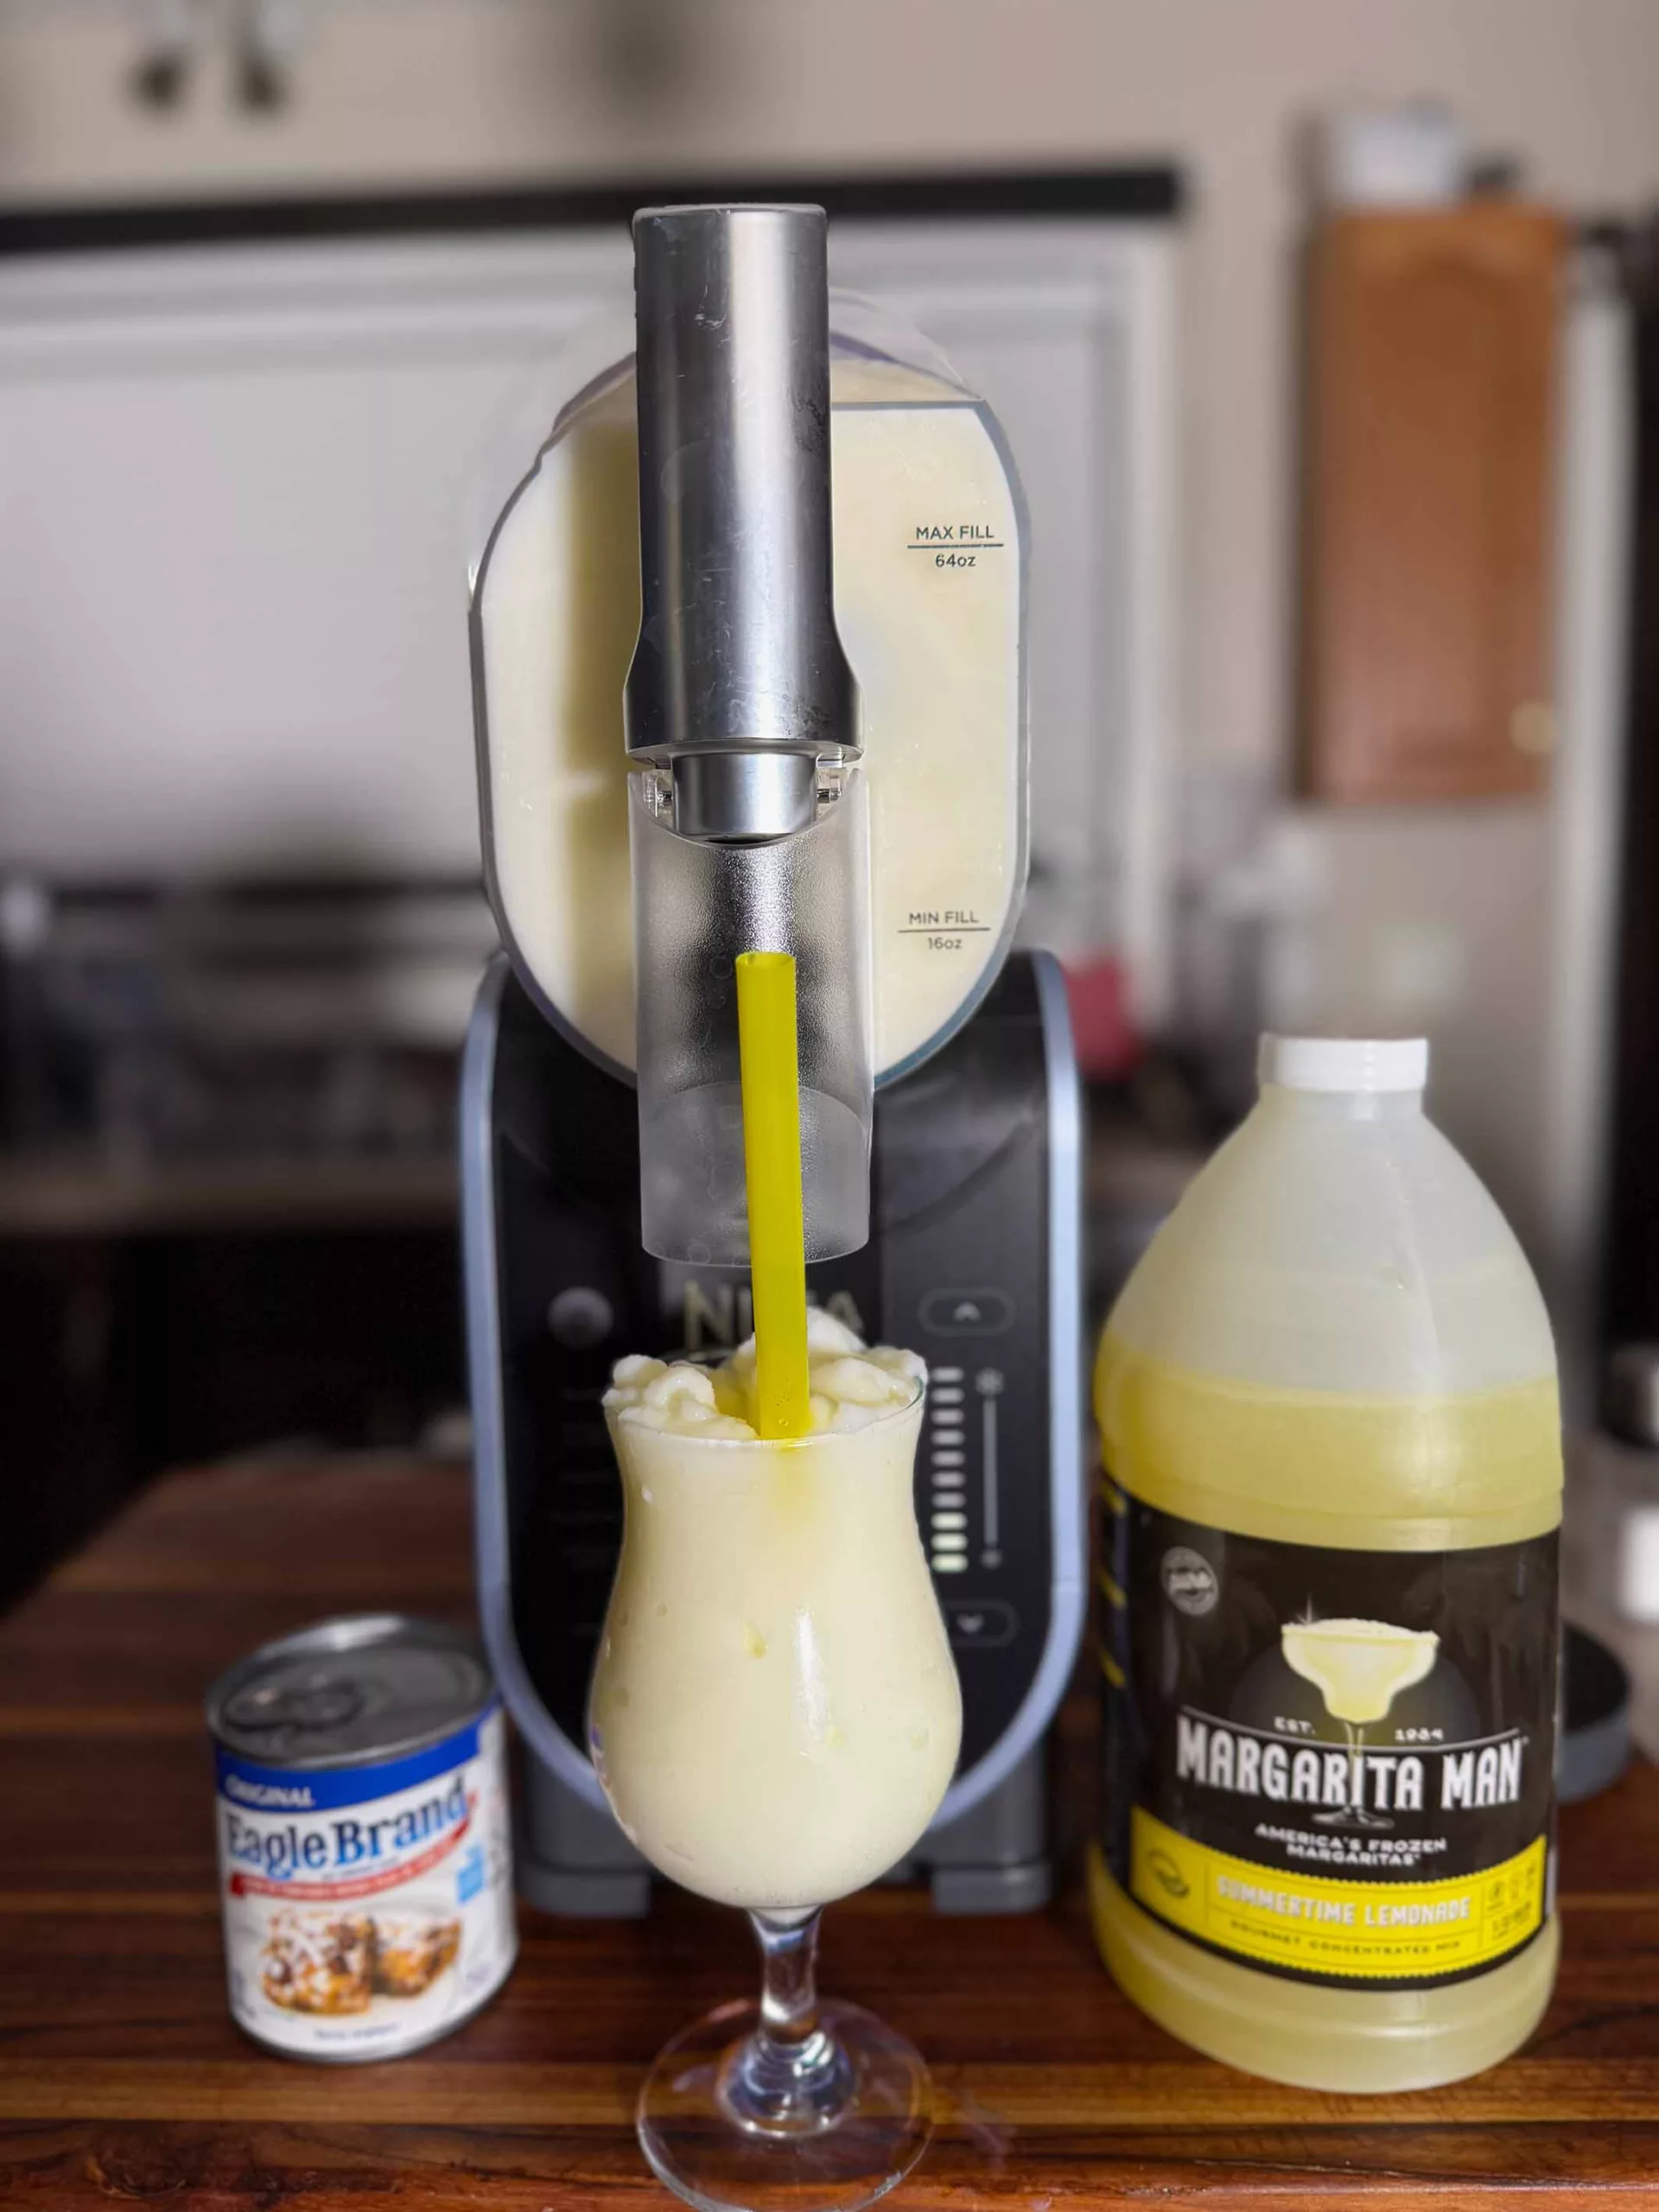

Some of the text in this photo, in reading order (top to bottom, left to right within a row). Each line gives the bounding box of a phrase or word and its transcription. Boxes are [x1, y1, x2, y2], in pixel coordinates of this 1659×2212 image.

[916, 524, 995, 540] MAX FILL
[935, 554, 977, 568] 64oz
[909, 910, 979, 925] MIN FILL
[928, 937, 963, 950] 16oz
[683, 1279, 865, 1351] NIA
[1176, 1716, 1523, 1811] MARGARITA MAN
[226, 1813, 327, 1881] Eagle
[330, 1773, 468, 1866] Brand
[1255, 1822, 1447, 1853] AMERICA'S FROZEN
[1217, 1873, 1357, 1927] SUMMERTIME
[1364, 1896, 1471, 1928] LEMONADE
